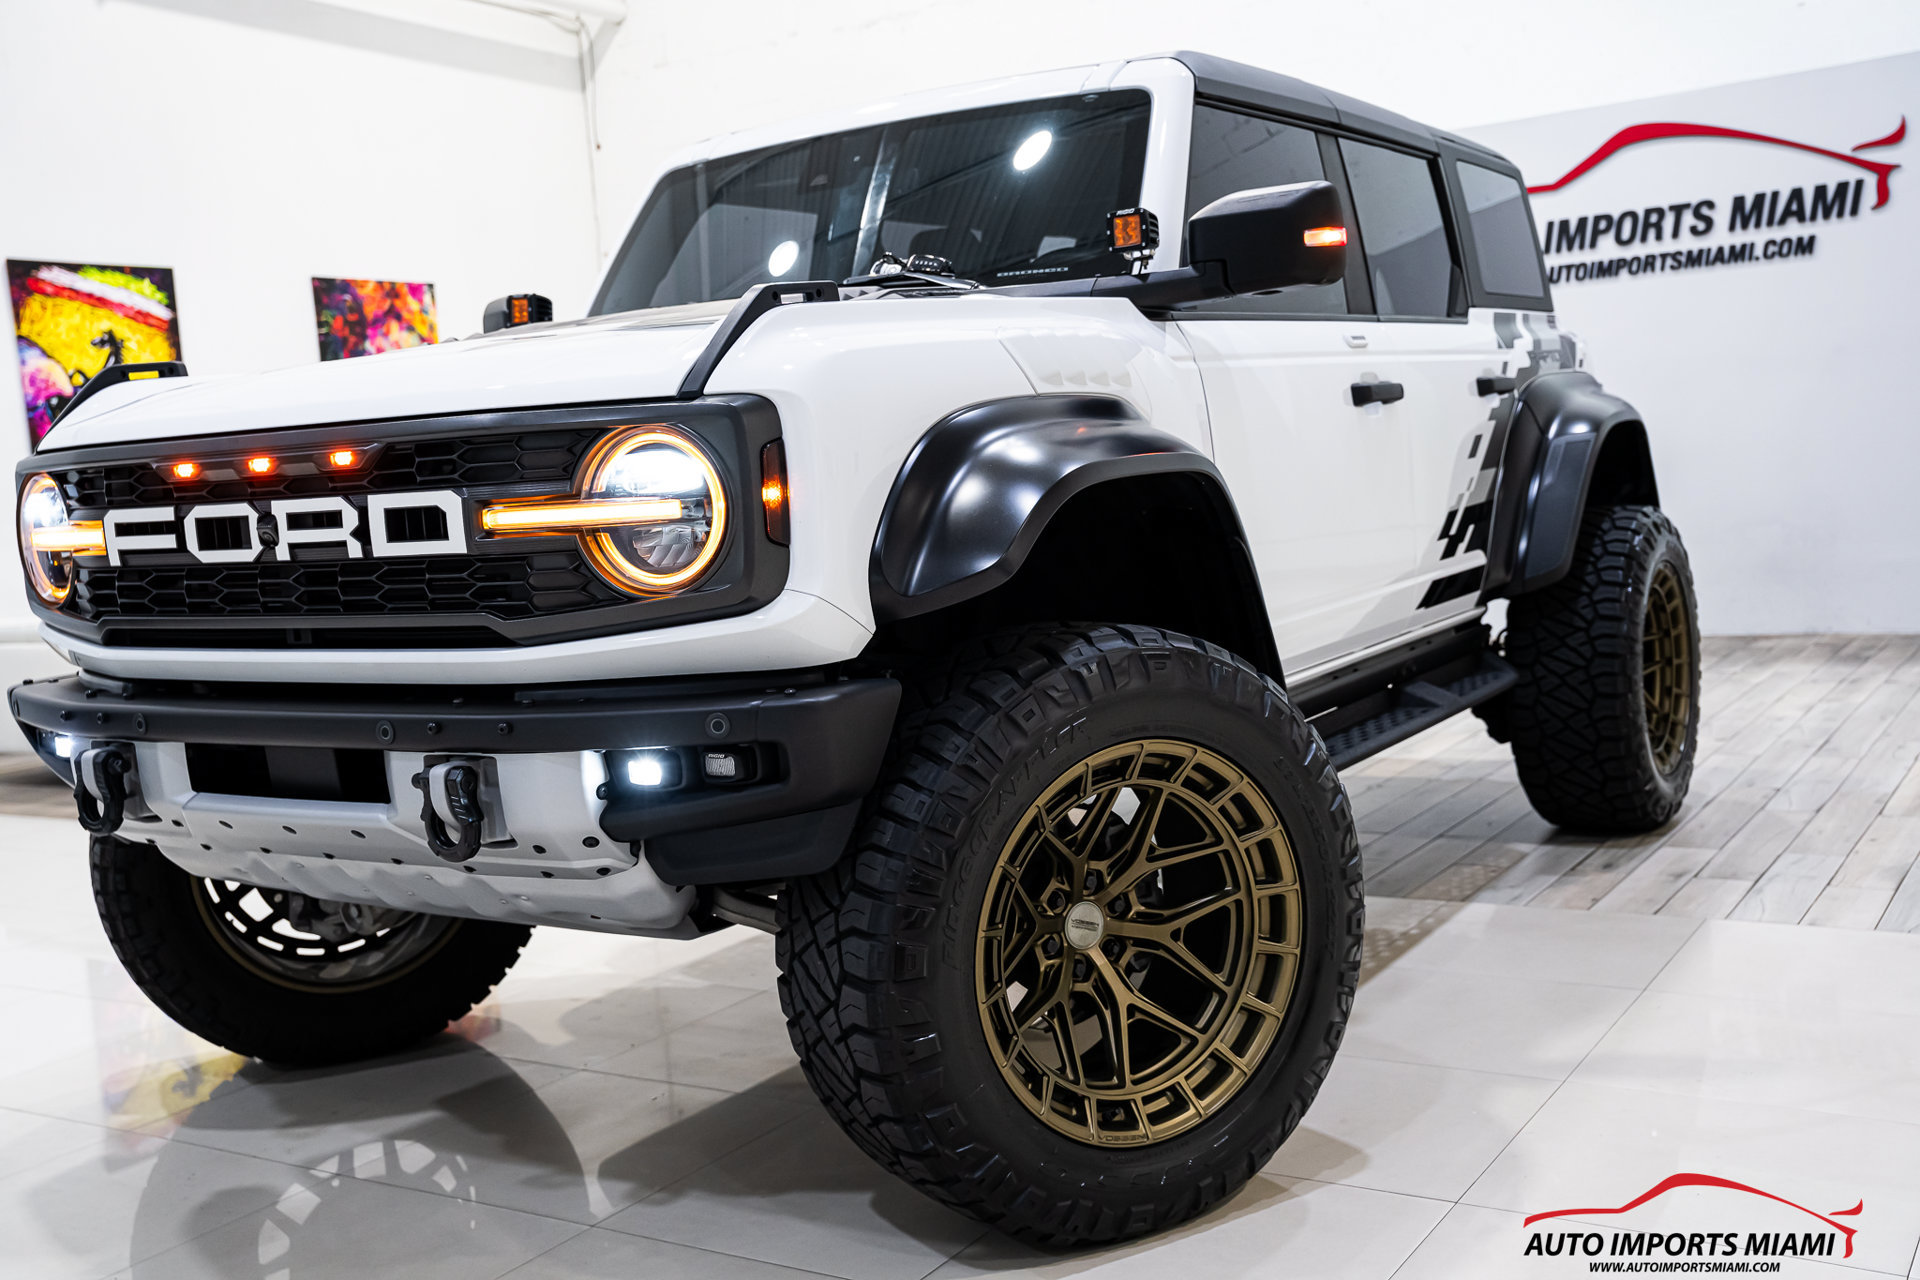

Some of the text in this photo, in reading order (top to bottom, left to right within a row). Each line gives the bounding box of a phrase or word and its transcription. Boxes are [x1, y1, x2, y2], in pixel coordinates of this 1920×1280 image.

[1545, 179, 1865, 255] IMPORTS MIAMI
[104, 489, 468, 567] FORD
